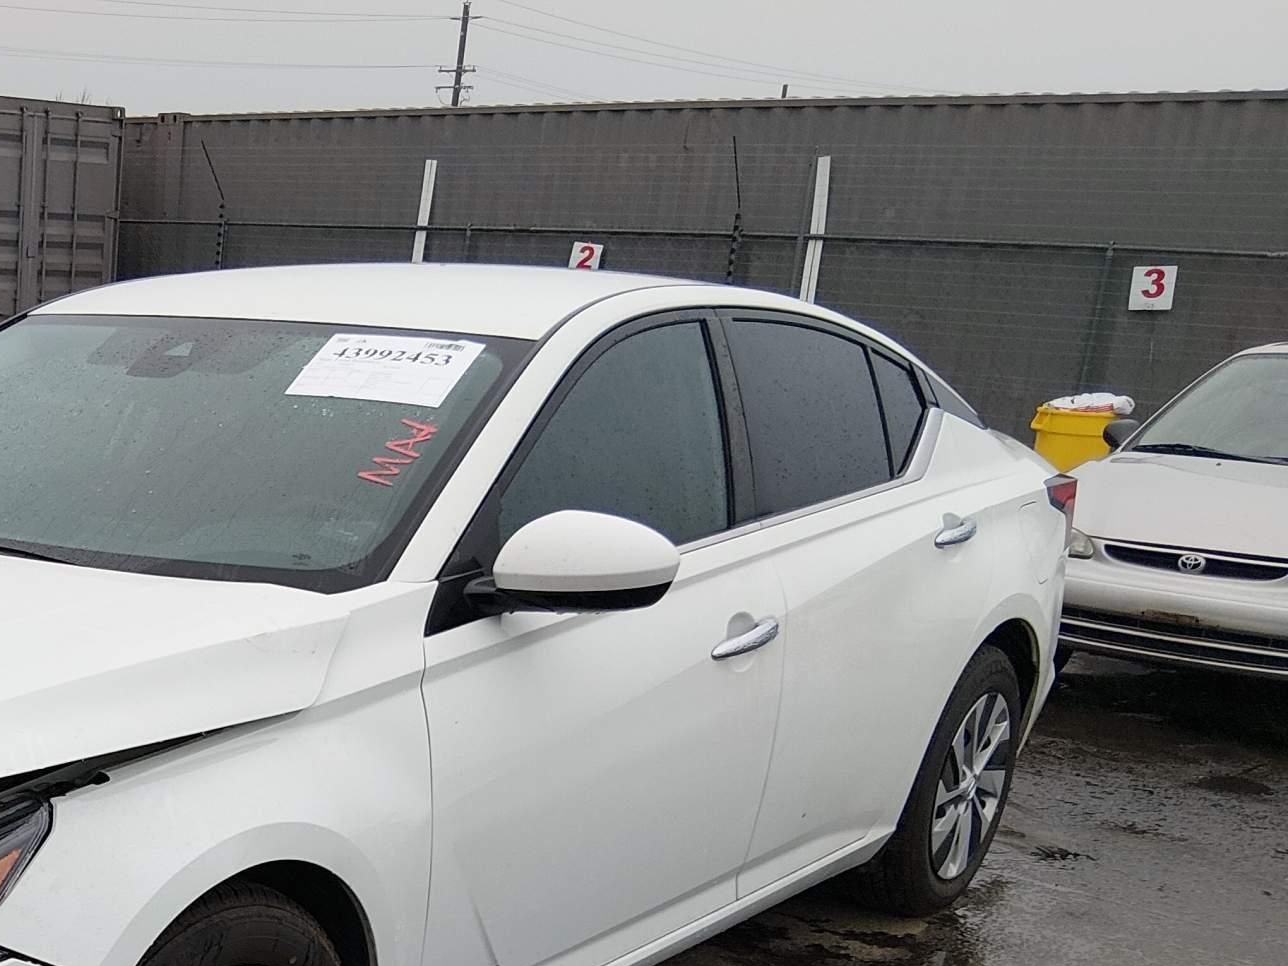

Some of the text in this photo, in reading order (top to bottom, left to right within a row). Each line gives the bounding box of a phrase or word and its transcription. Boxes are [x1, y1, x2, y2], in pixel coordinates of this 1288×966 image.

[576, 245, 595, 269] 2
[1141, 268, 1166, 299] 3
[333, 347, 453, 366] 43992453
